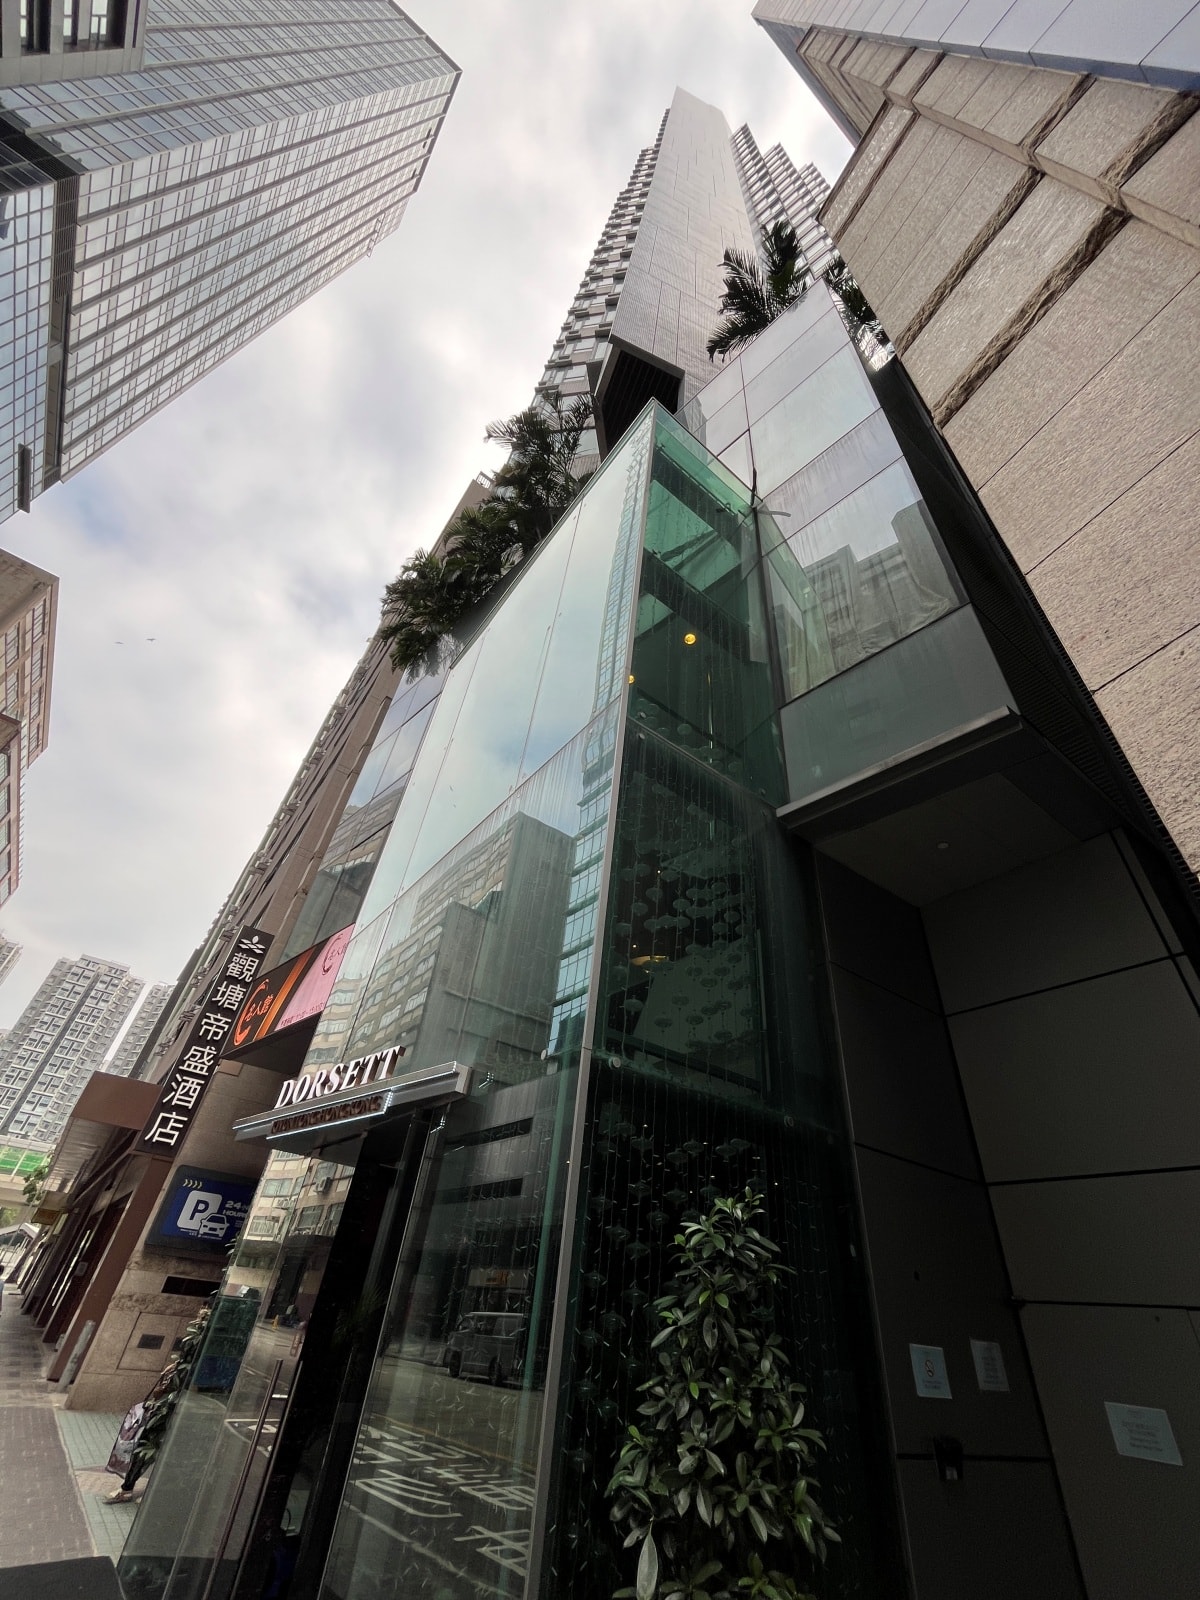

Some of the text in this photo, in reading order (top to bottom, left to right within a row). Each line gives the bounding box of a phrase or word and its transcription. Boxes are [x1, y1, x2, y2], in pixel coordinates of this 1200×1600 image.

[144, 951, 260, 1146] 觀塘帝盛酒店
[272, 1045, 402, 1111] DORSETT
[189, 1199, 210, 1221] P
